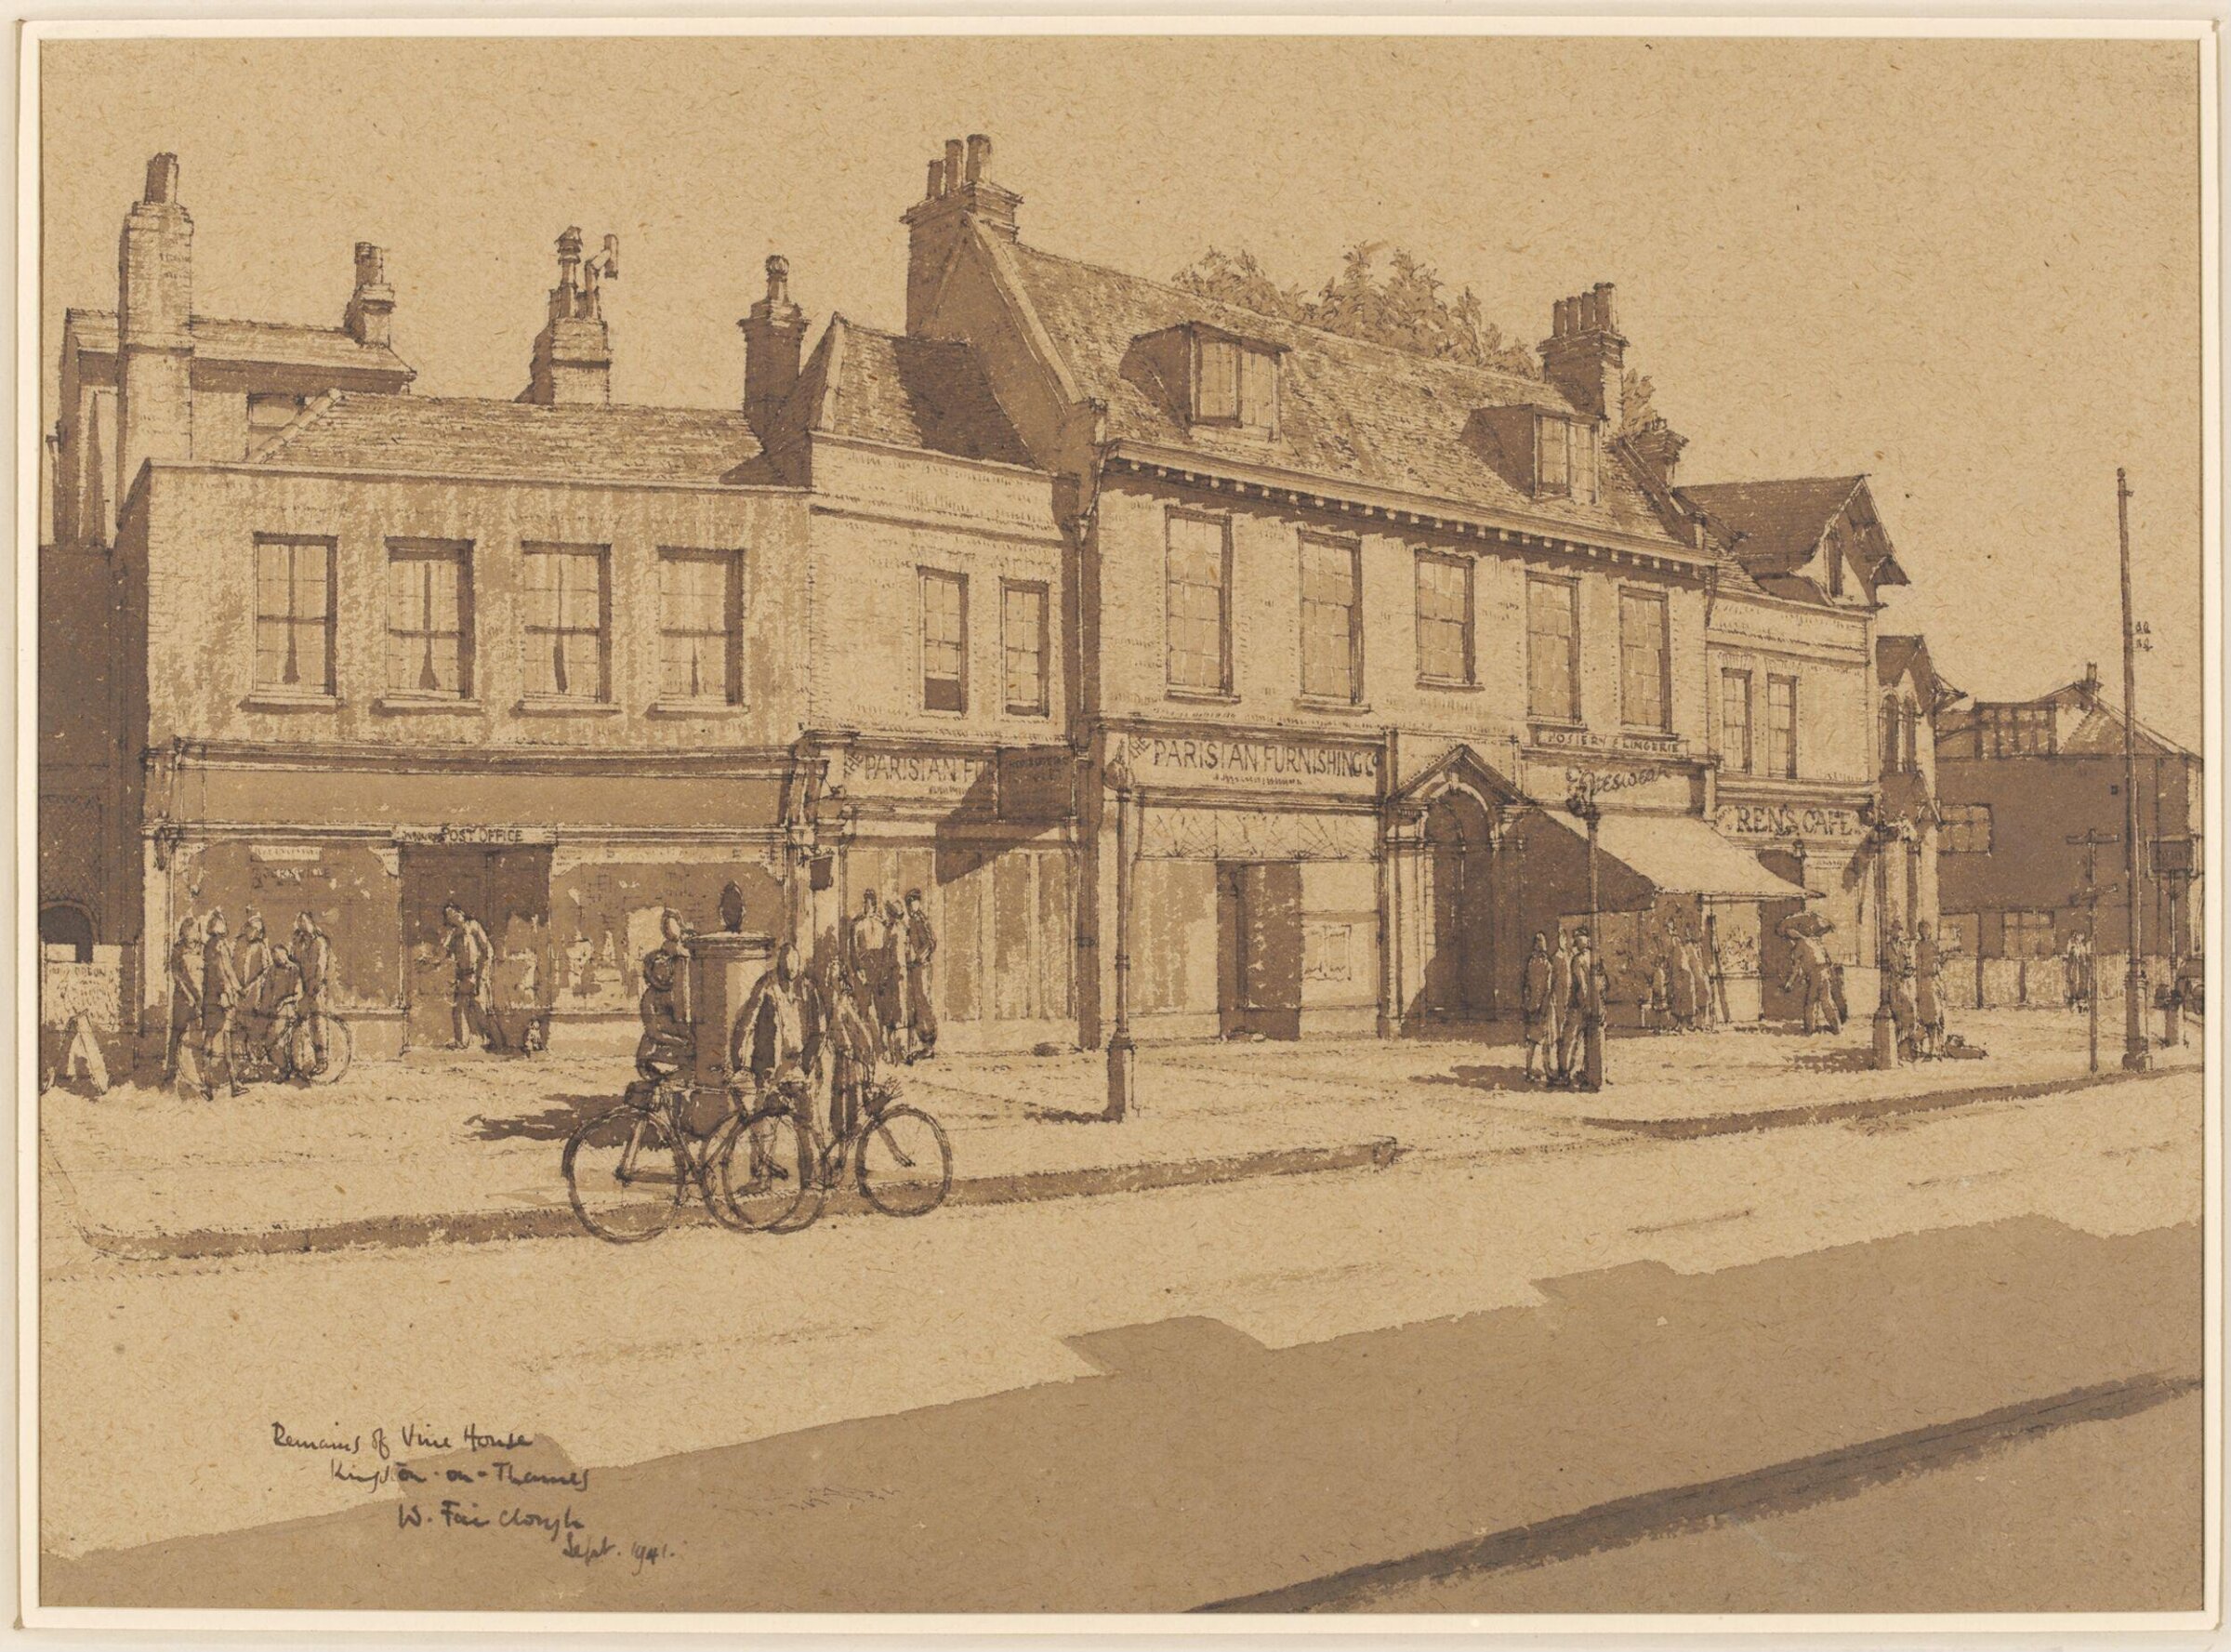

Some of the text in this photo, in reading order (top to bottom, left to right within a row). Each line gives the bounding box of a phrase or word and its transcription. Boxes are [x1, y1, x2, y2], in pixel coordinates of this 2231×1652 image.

[1154, 739, 1257, 773] PARISIAN
[1263, 745, 1363, 777] FURNISHING
[1622, 739, 1680, 754] LINGERIE
[865, 754, 957, 782] PARISIAN
[479, 826, 524, 844] OFFICE
[271, 1421, 534, 1460] Remains of Vine House
[398, 1502, 433, 1529] W.
